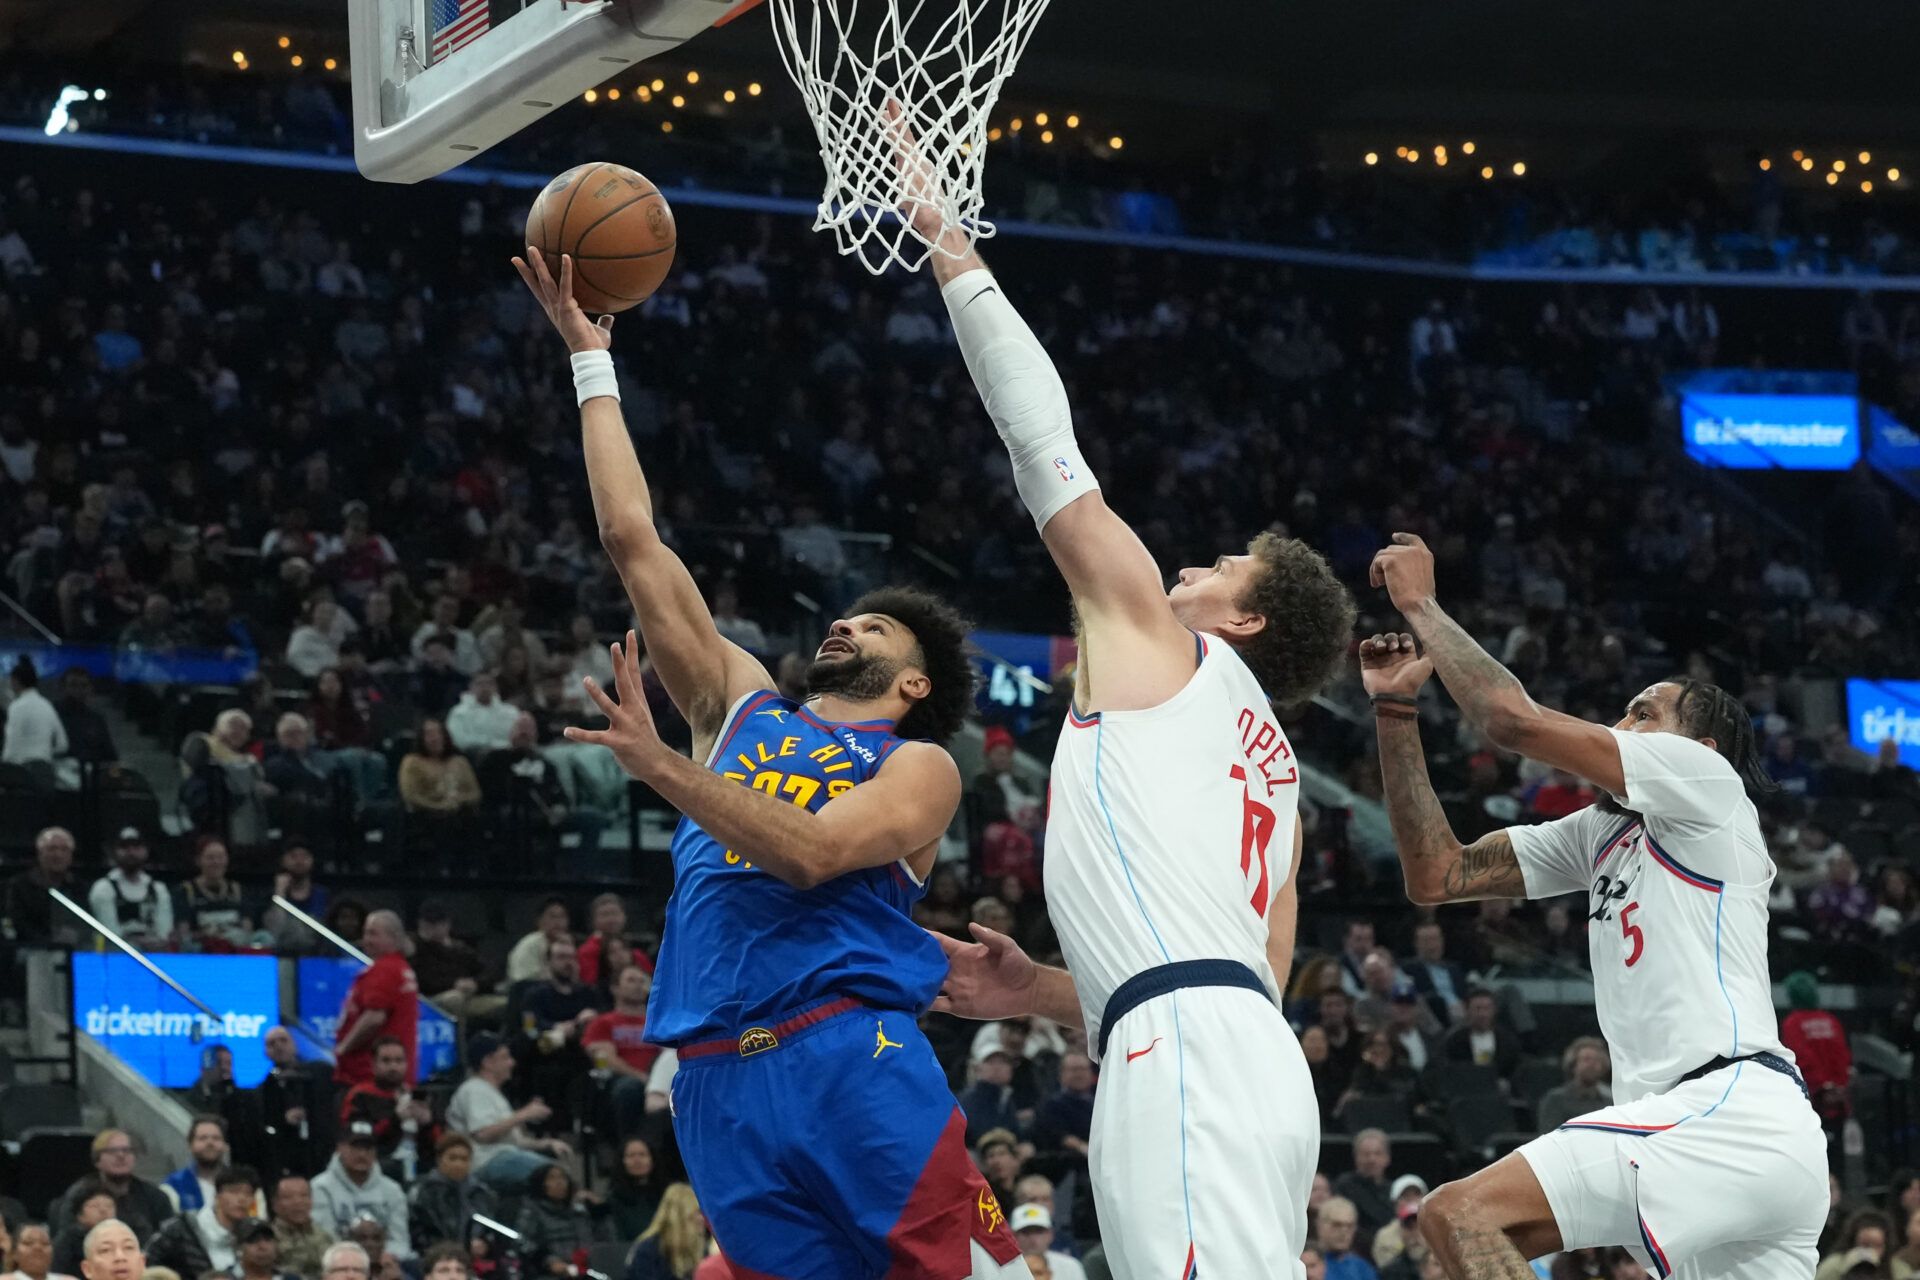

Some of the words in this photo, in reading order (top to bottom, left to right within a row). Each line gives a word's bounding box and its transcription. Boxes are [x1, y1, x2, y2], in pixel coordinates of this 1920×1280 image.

[989, 664, 1034, 707] 41
[723, 736, 802, 784] ILE
[808, 743, 855, 798] HIG
[1619, 901, 1644, 967] 5
[86, 1004, 267, 1038] ticketmaster
